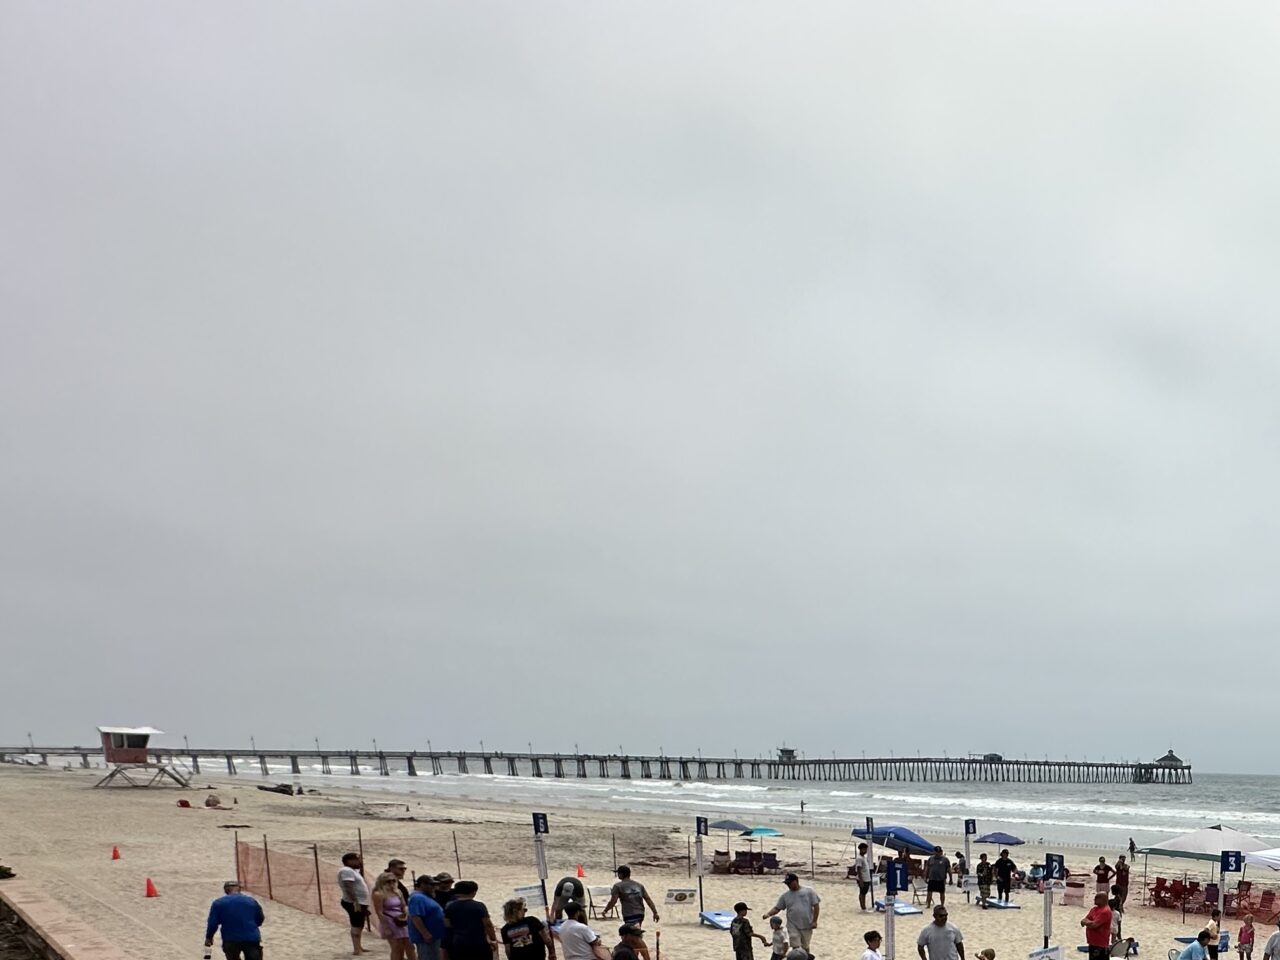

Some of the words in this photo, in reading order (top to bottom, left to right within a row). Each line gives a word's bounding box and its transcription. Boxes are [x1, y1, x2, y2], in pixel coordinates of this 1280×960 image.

[1052, 862, 1060, 878] 2
[1228, 857, 1236, 870] 3
[896, 869, 902, 889] 1
